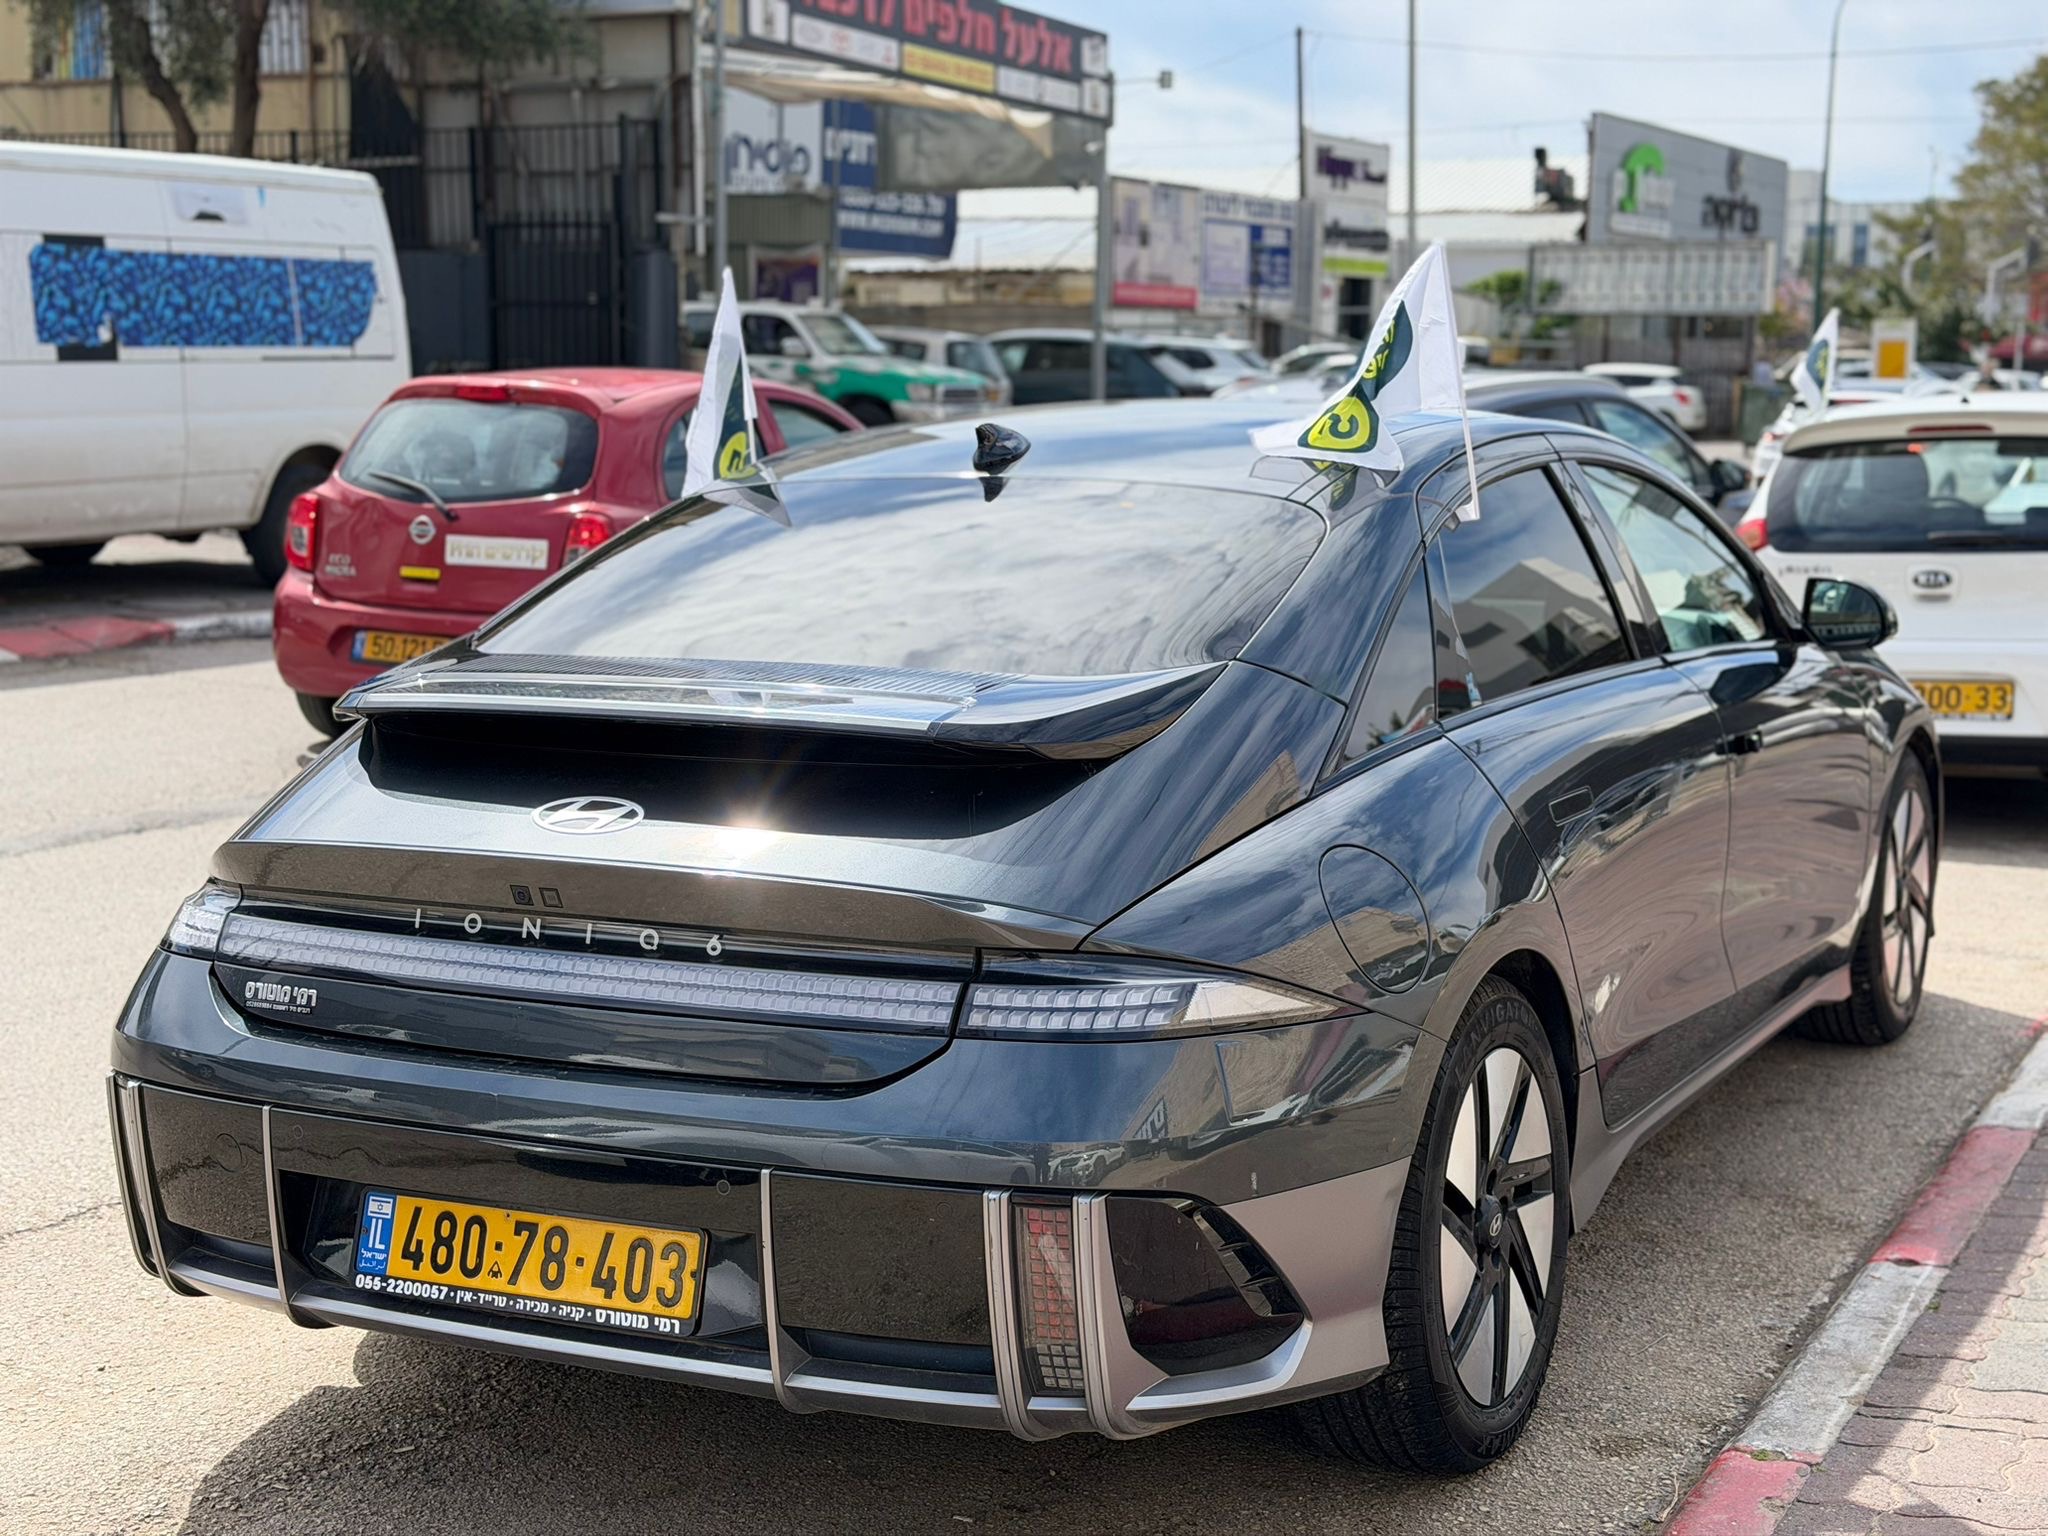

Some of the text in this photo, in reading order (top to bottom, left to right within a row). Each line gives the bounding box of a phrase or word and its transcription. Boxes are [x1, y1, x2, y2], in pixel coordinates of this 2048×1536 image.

[903, 0, 997, 55] חלפים
[1002, 8, 1072, 73] אלעל
[414, 908, 723, 956] IONIQ 6
[245, 981, 292, 1003] מוטורס
[293, 986, 318, 1007] רמי
[368, 1218, 385, 1249] IL
[360, 1248, 387, 1260] ישראל
[355, 1273, 681, 1334] רמי מוטורס קניה מכירה טרייד-אין 055-2200057
